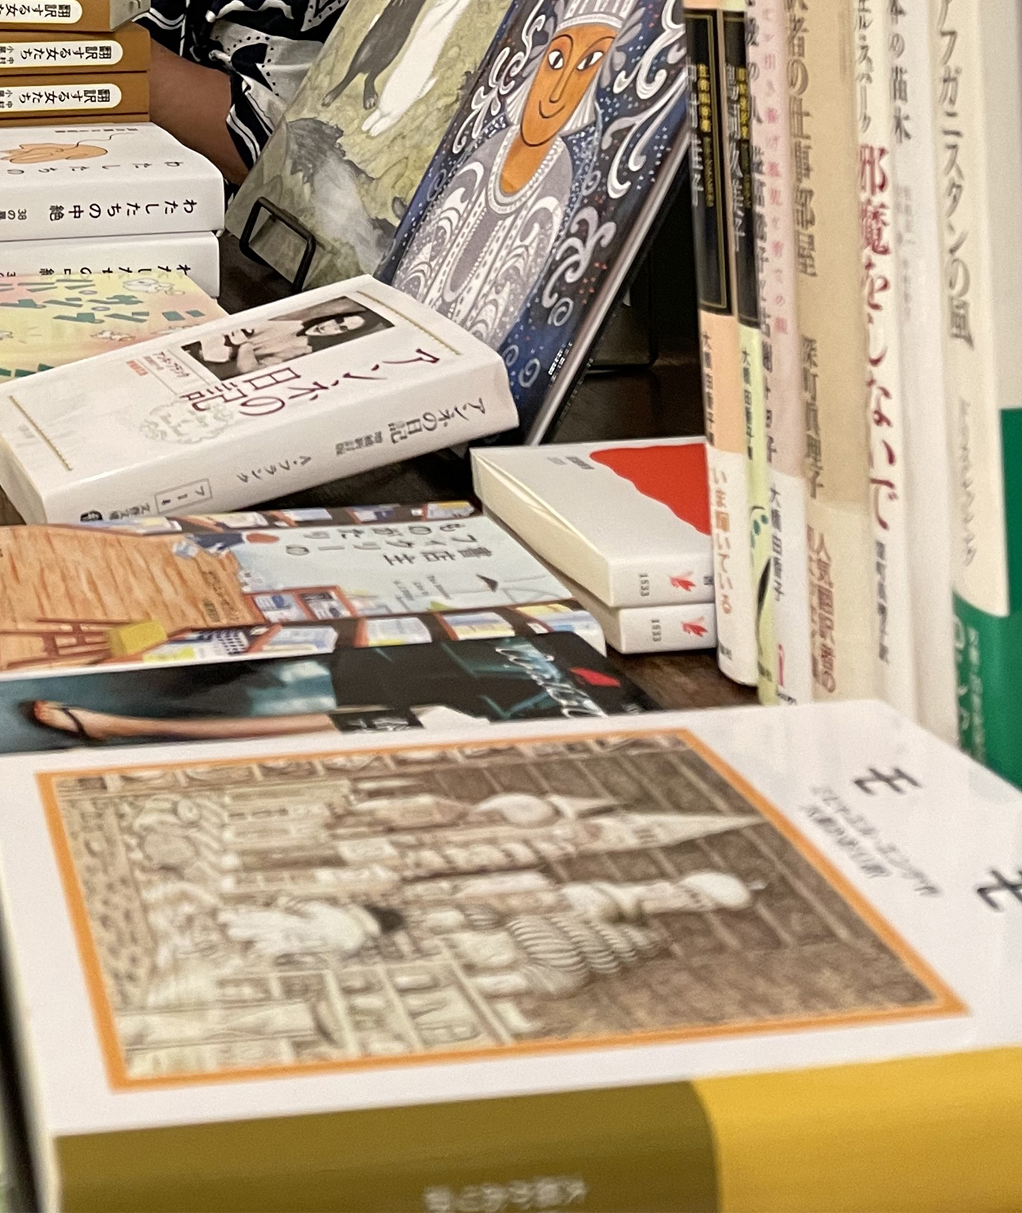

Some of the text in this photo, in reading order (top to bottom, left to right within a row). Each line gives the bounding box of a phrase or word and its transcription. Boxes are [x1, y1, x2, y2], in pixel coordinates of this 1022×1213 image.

[20, 45, 113, 60] 翻訳する女たち
[19, 88, 111, 104] 翻訳する女たち
[49, 197, 198, 222] わたしたちの中絶
[857, 142, 899, 531] 邪魔をしないで
[179, 366, 303, 413] 日記
[240, 346, 441, 419] アンネの
[387, 396, 487, 445] アンネの日記
[382, 546, 493, 566] 書店主
